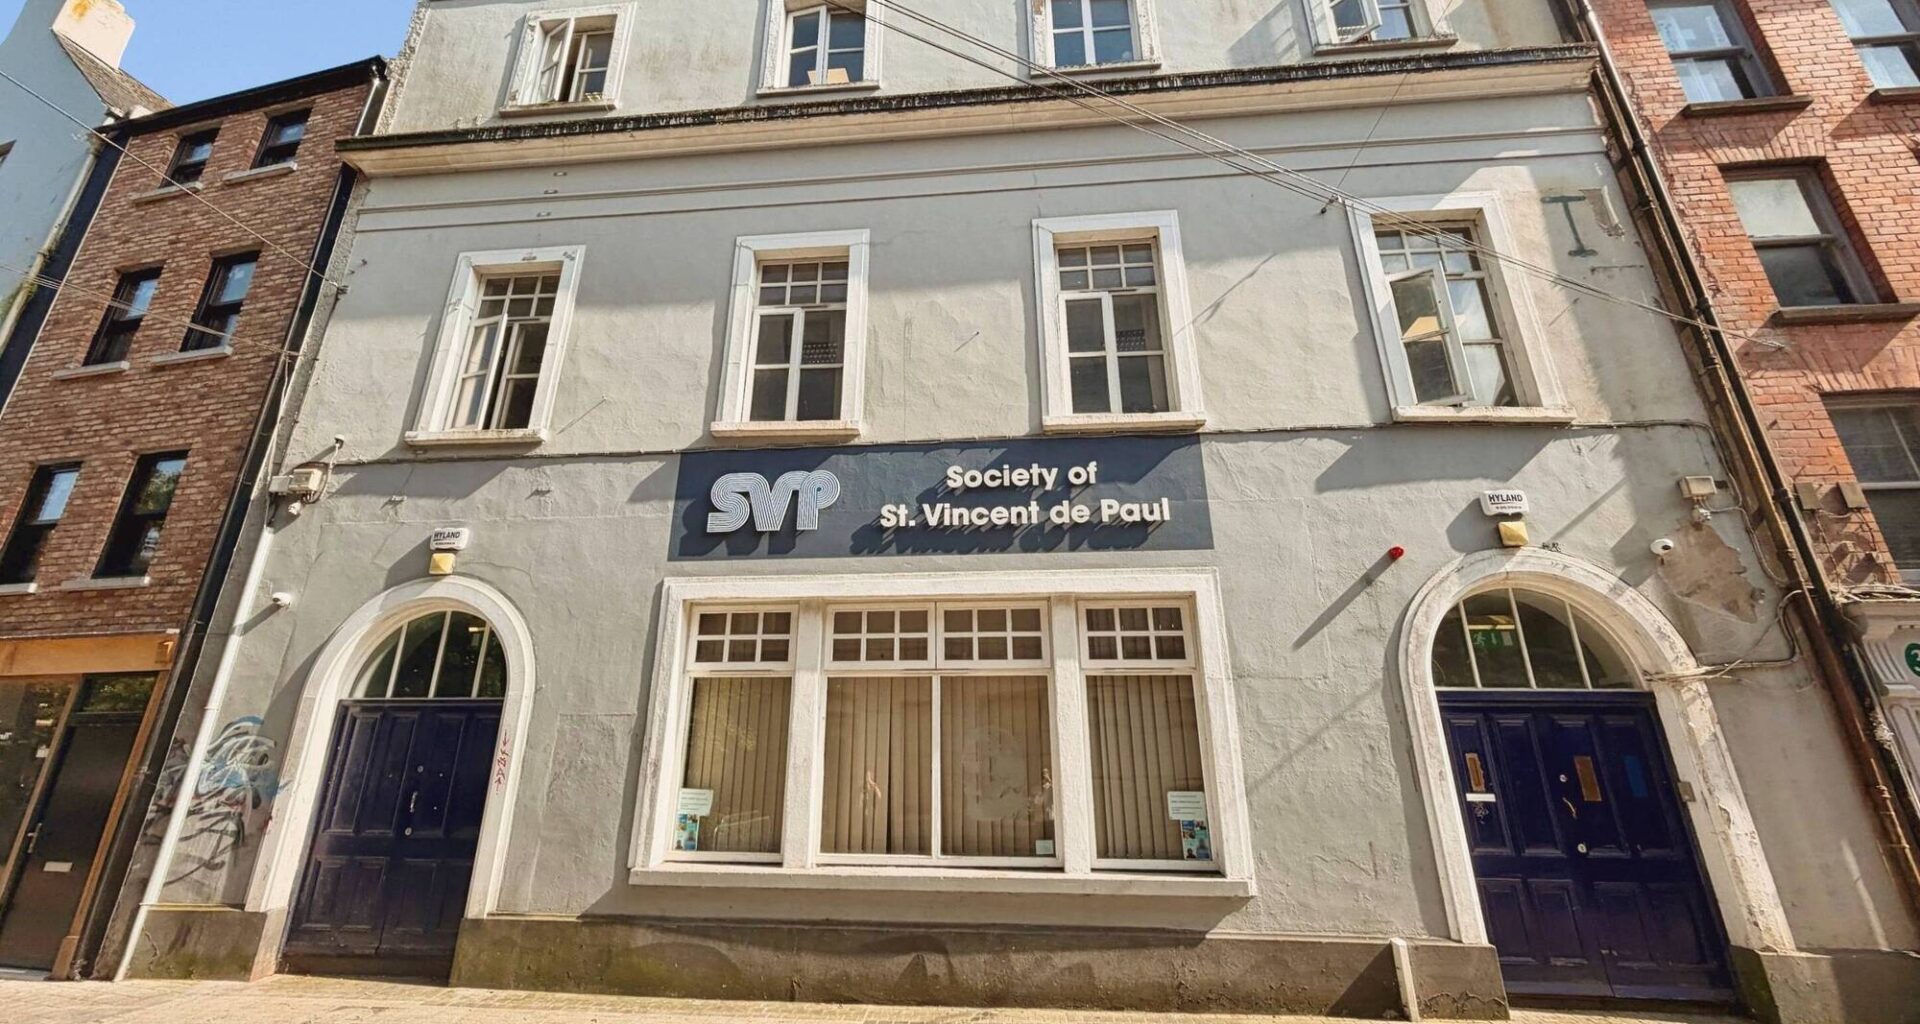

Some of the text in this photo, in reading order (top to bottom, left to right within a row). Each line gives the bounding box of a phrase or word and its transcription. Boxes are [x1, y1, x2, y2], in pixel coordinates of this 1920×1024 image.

[947, 461, 1098, 490] Society of
[706, 469, 841, 532] SVP
[880, 497, 1171, 527] St. Vincent de Paul
[1488, 494, 1523, 502] HYLAND
[434, 531, 461, 539] HYLAND
